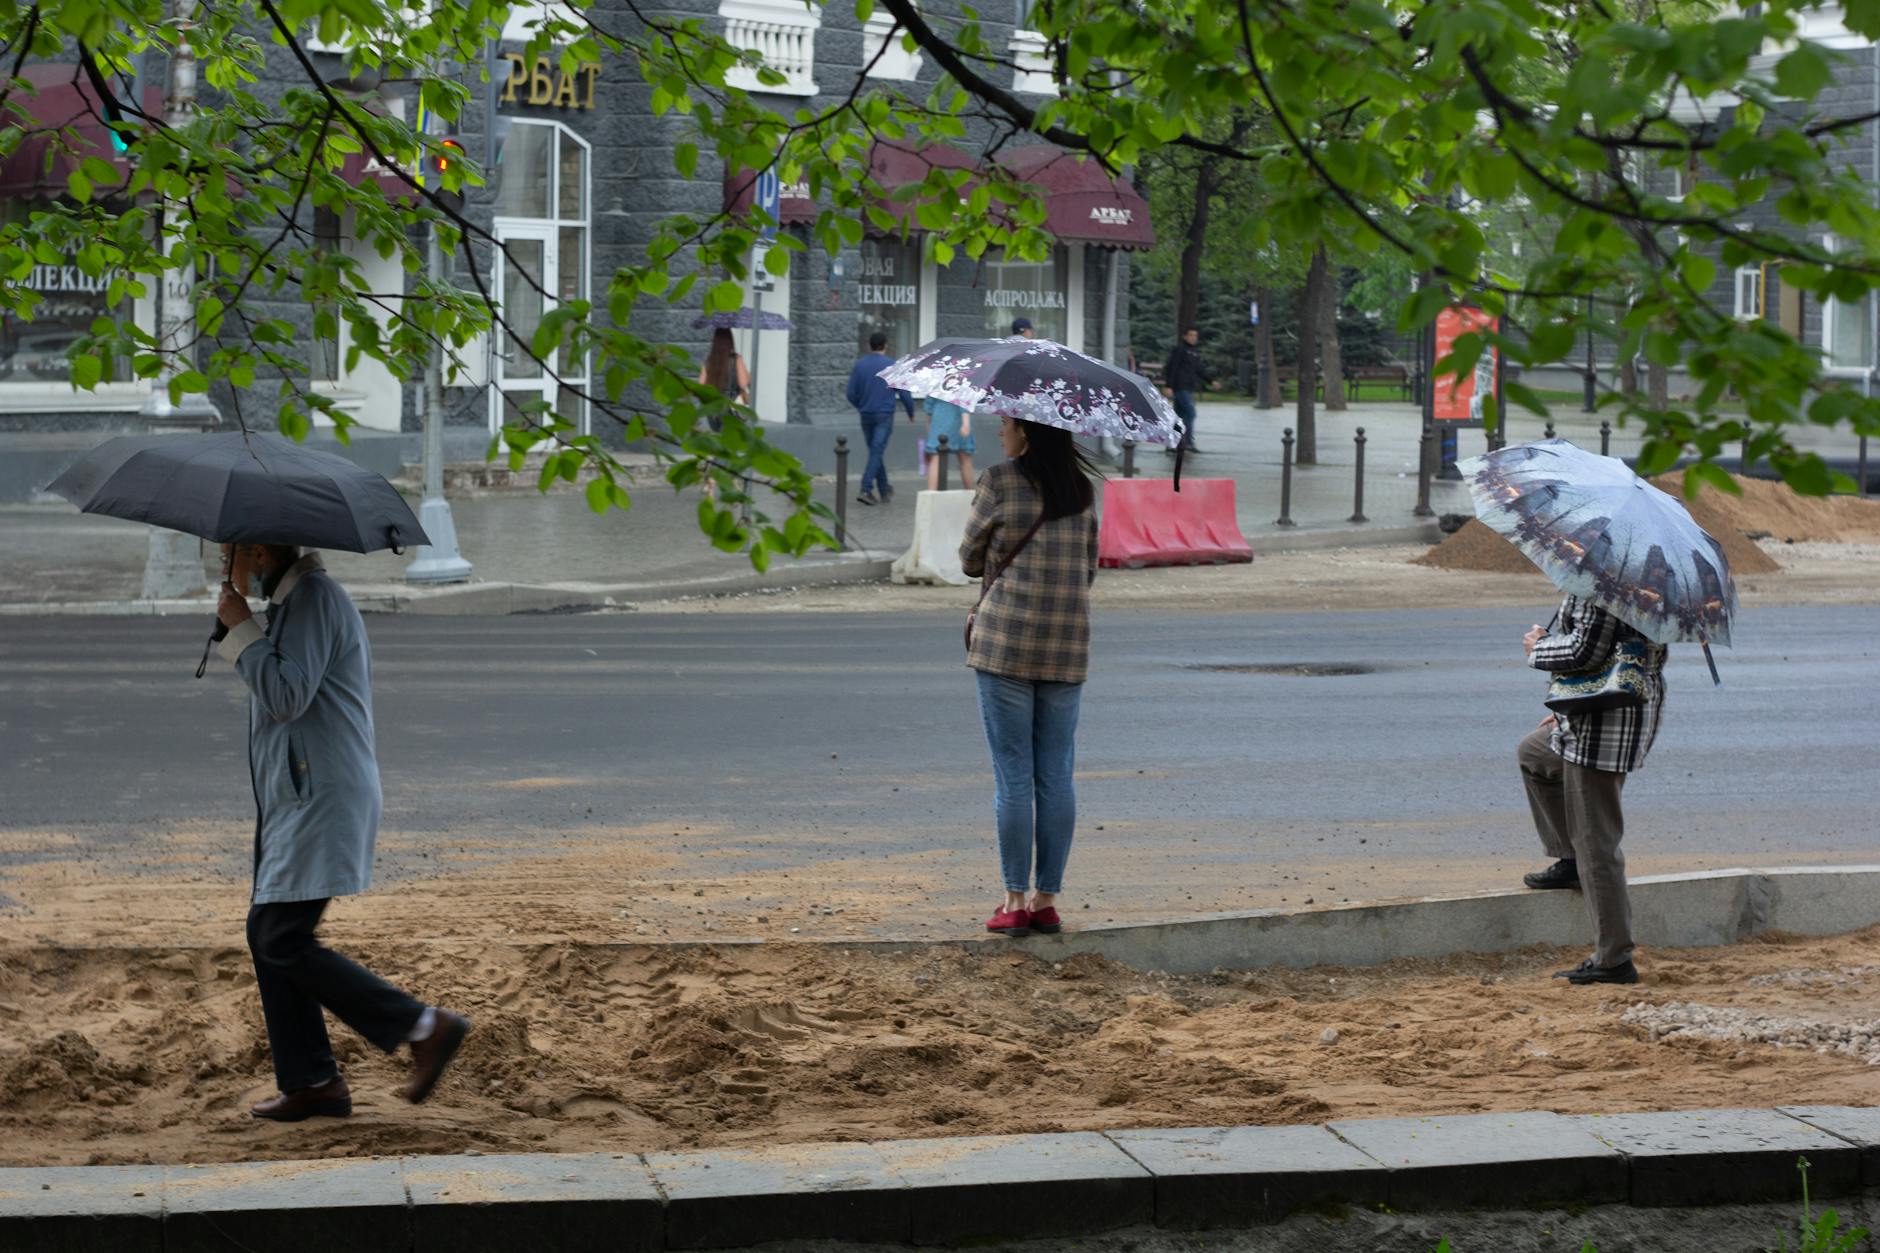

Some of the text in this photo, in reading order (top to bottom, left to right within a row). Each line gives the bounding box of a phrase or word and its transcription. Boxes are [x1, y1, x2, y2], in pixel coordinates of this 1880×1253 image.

[1089, 207, 1134, 222] АРБАТ
[5, 264, 122, 296] ЛЕКЦИ
[984, 289, 1066, 309] АСПРОДАЖА
